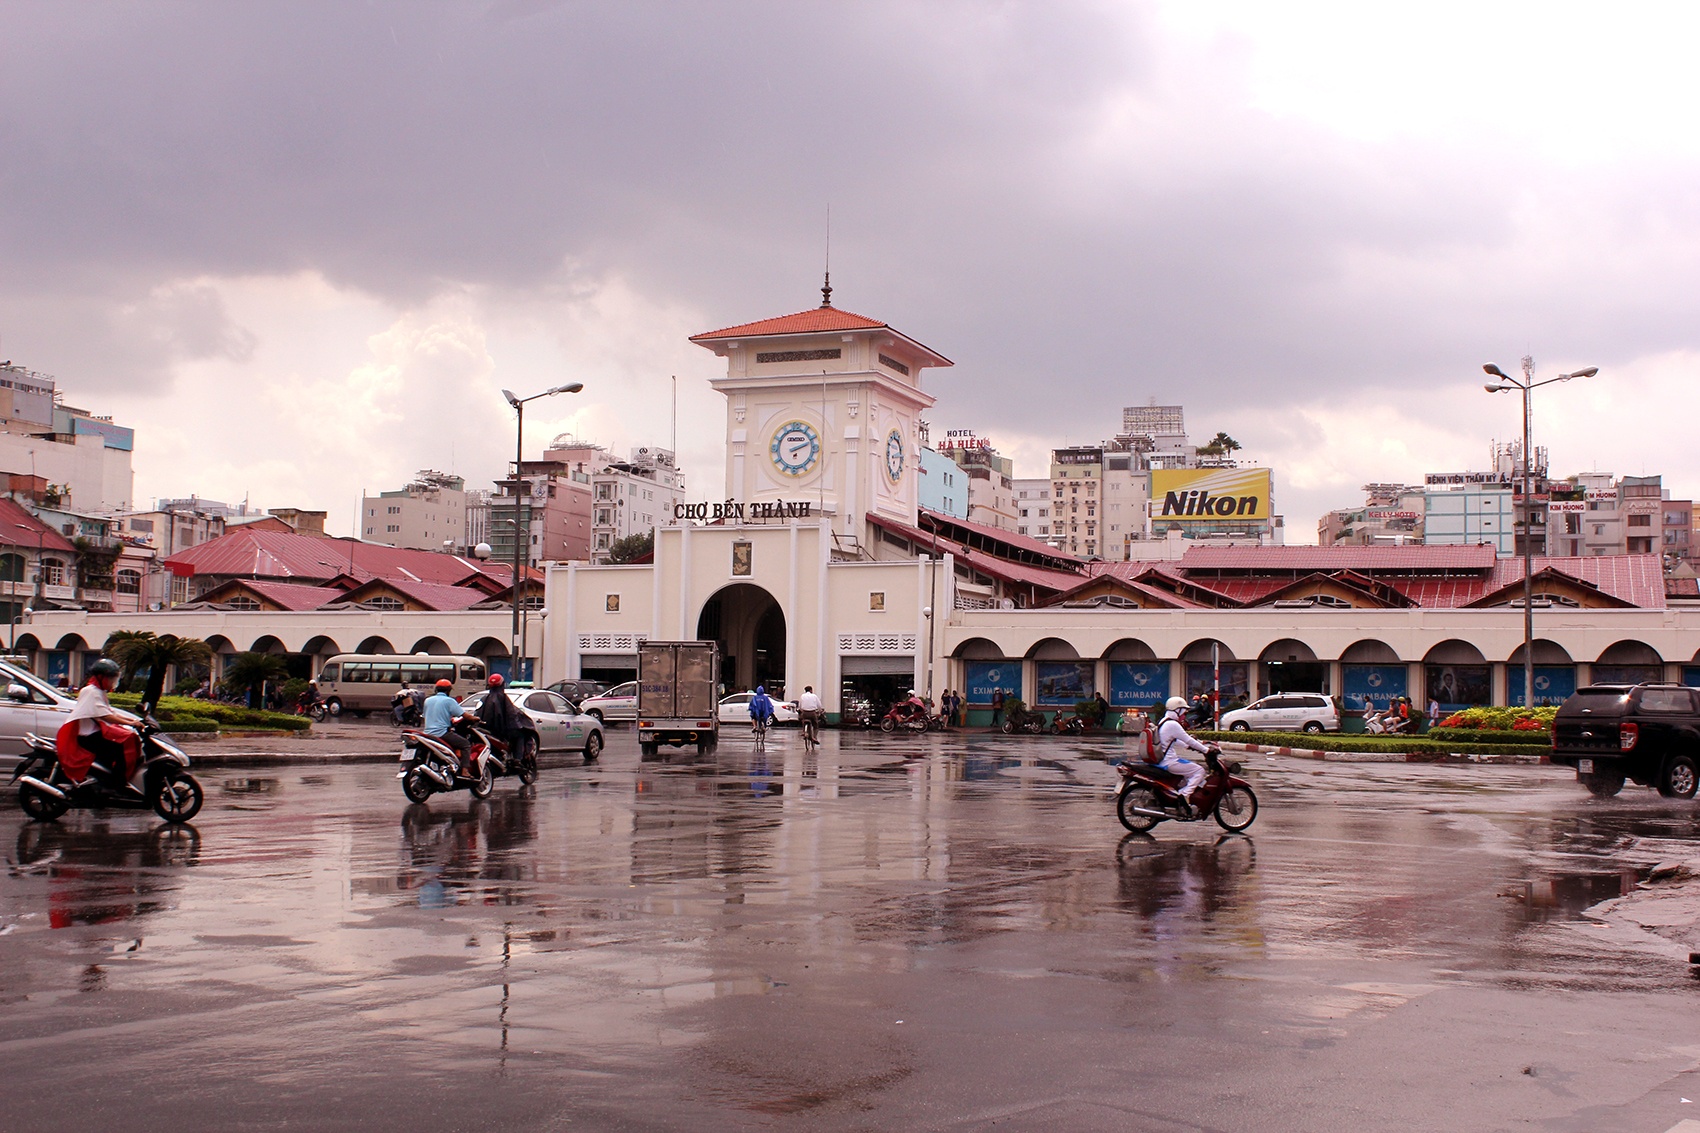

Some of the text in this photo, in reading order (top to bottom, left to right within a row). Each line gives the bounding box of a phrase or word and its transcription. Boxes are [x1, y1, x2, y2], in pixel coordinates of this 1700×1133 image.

[947, 429, 974, 438] HOTEL
[674, 498, 811, 521] CHỢ BẾN THÀNH
[1161, 490, 1258, 516] Nikon
[1118, 691, 1162, 699] EXIMBANK
